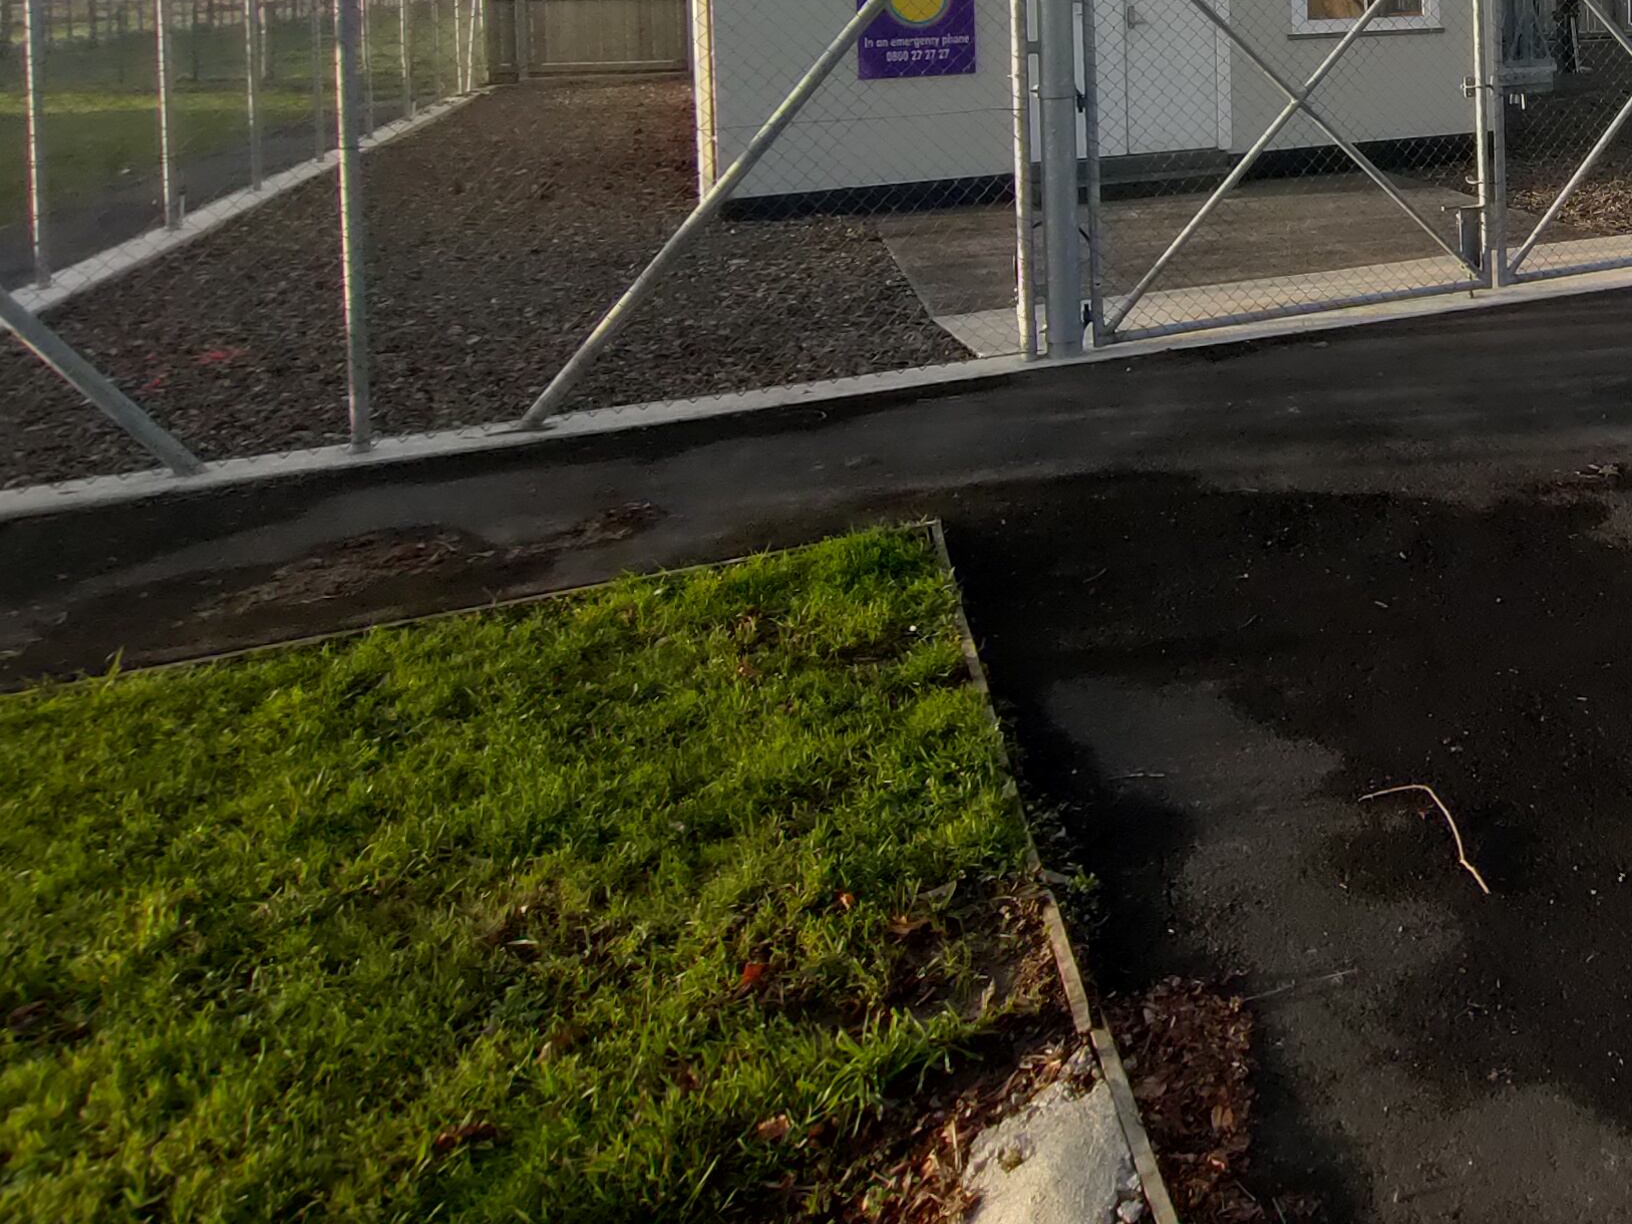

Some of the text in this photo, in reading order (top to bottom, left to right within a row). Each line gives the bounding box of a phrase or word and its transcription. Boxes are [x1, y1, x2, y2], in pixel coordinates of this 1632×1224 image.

[864, 37, 874, 48] In
[876, 39, 888, 48] an
[941, 33, 970, 47] phone
[911, 49, 923, 61] 27
[925, 48, 936, 61] 27
[938, 48, 951, 60] 27
